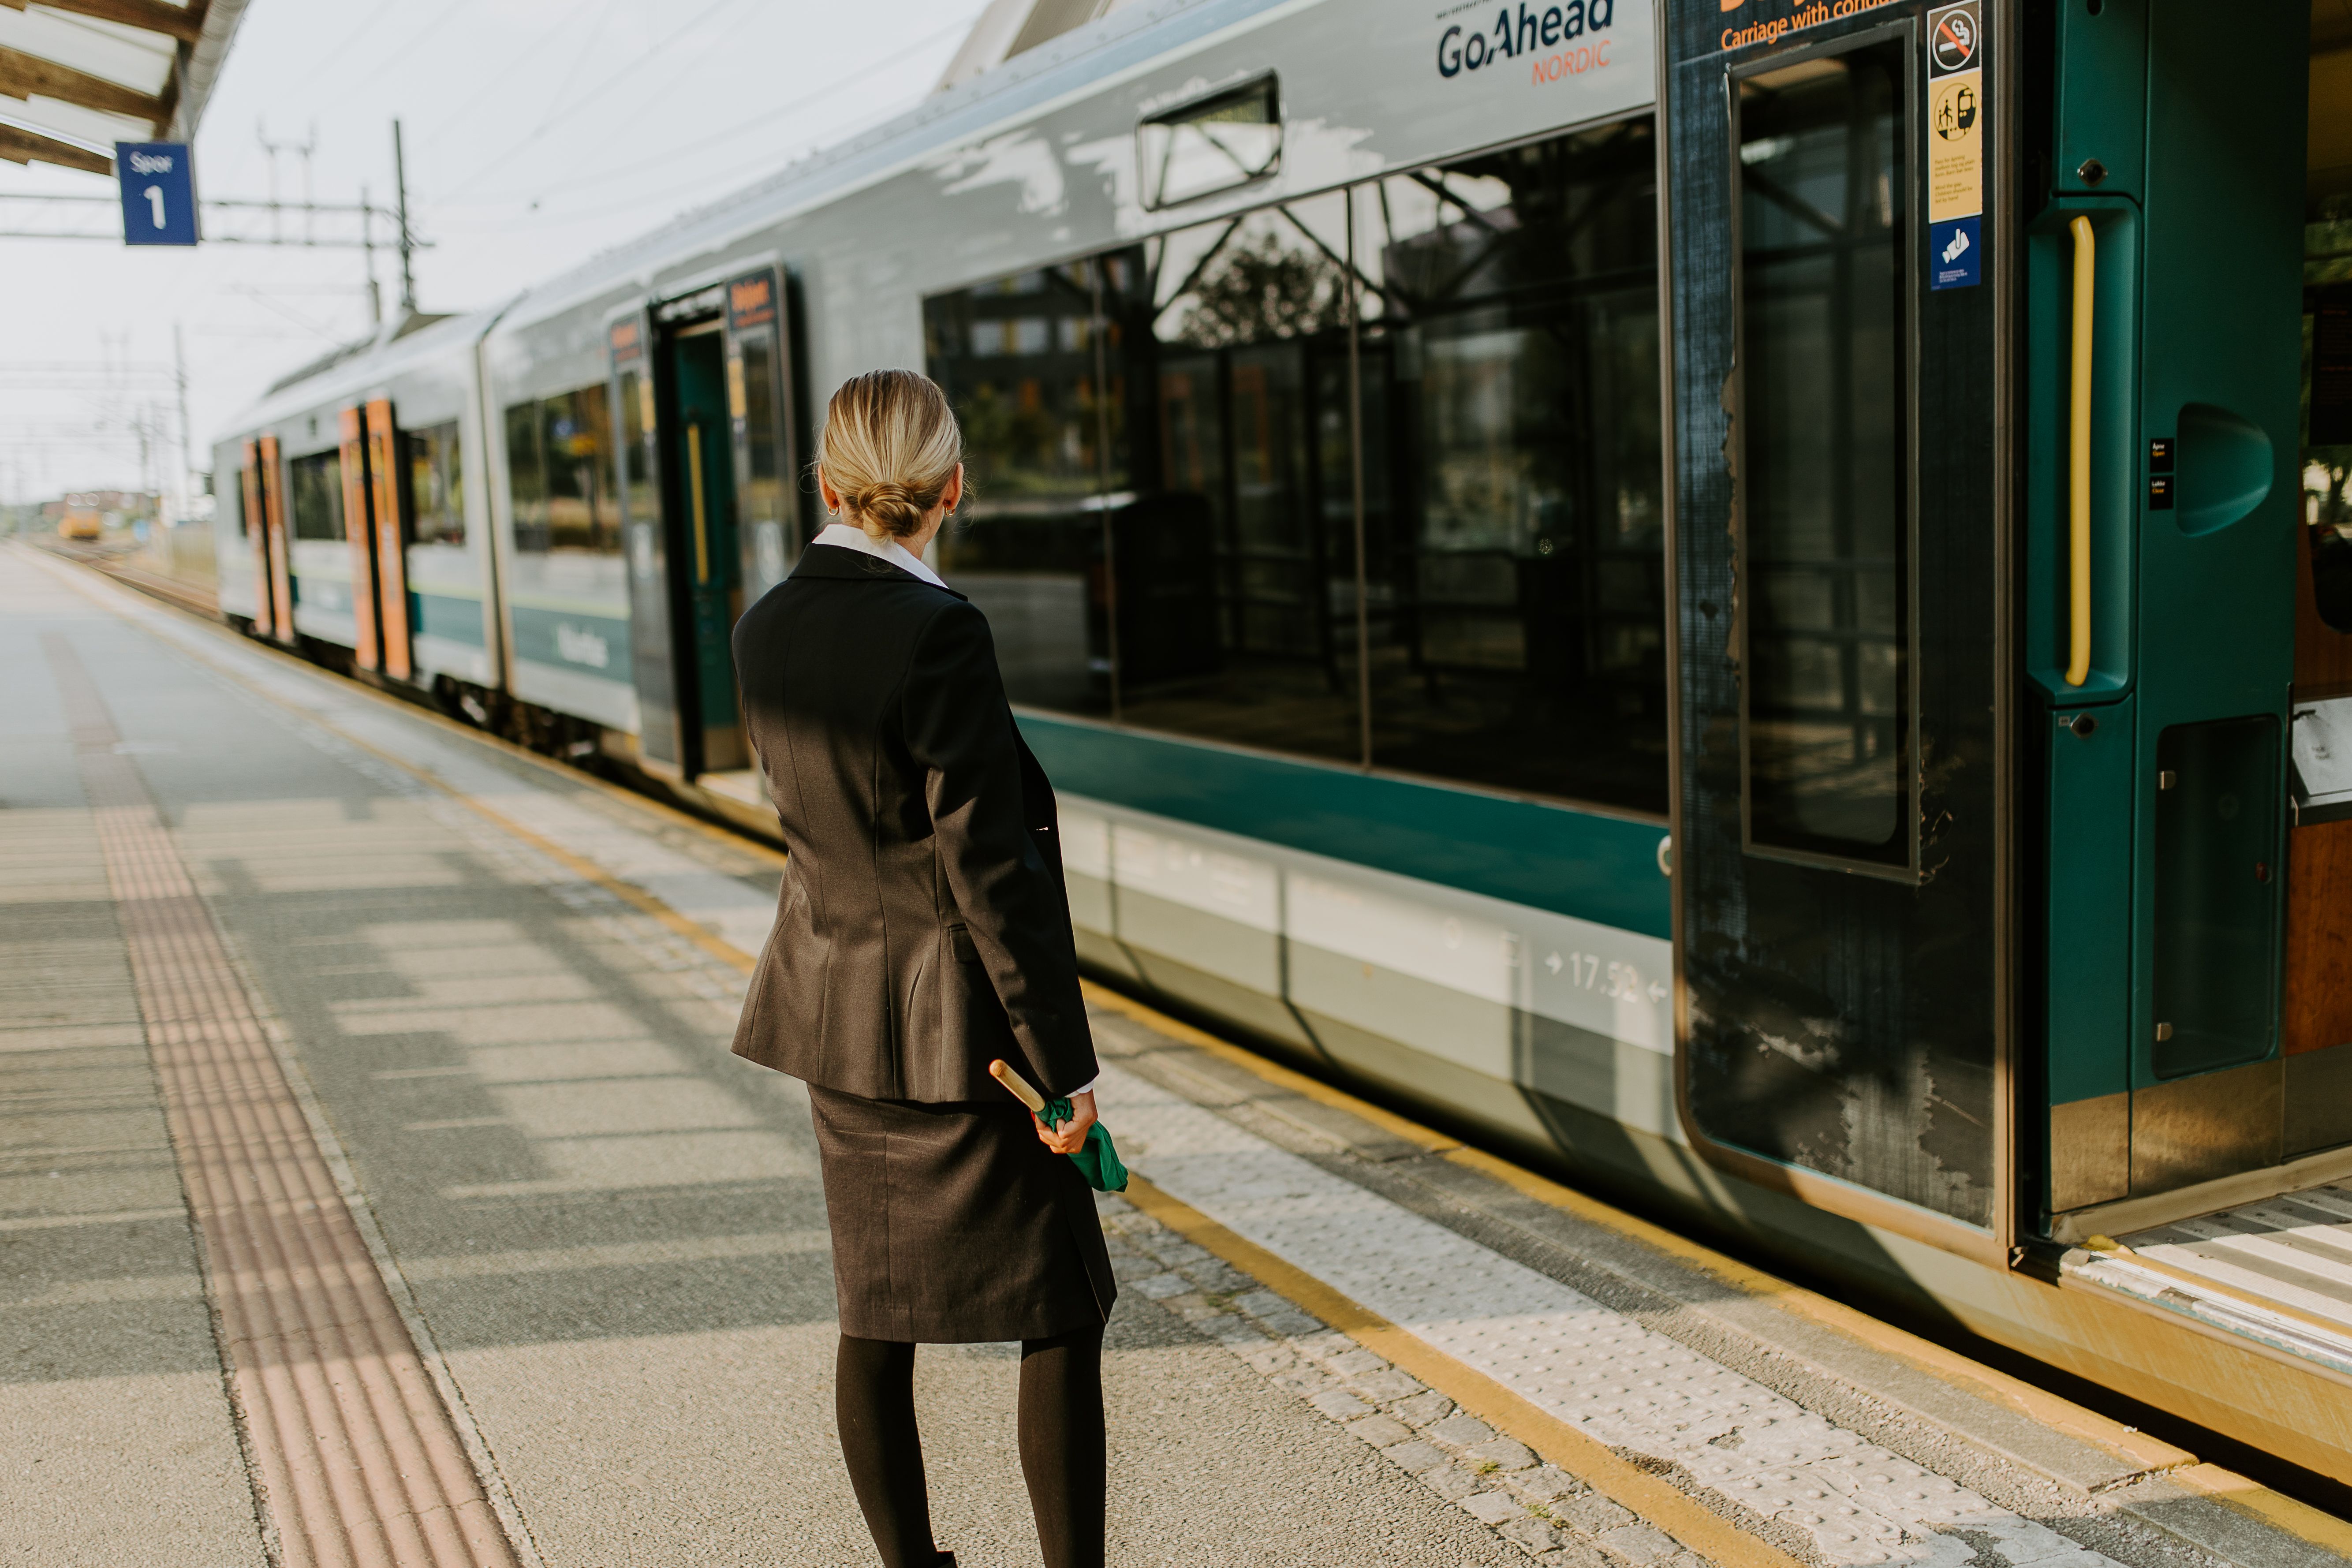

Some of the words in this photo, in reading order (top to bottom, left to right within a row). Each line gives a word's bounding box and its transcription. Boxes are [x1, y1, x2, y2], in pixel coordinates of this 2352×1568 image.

[1721, 17, 1788, 52] Carriage
[1791, 0, 1829, 31] with
[1532, 39, 1612, 86] NORDIC
[130, 151, 174, 177] Spor
[143, 185, 166, 230] 1
[1570, 951, 1639, 1003] 17.52
